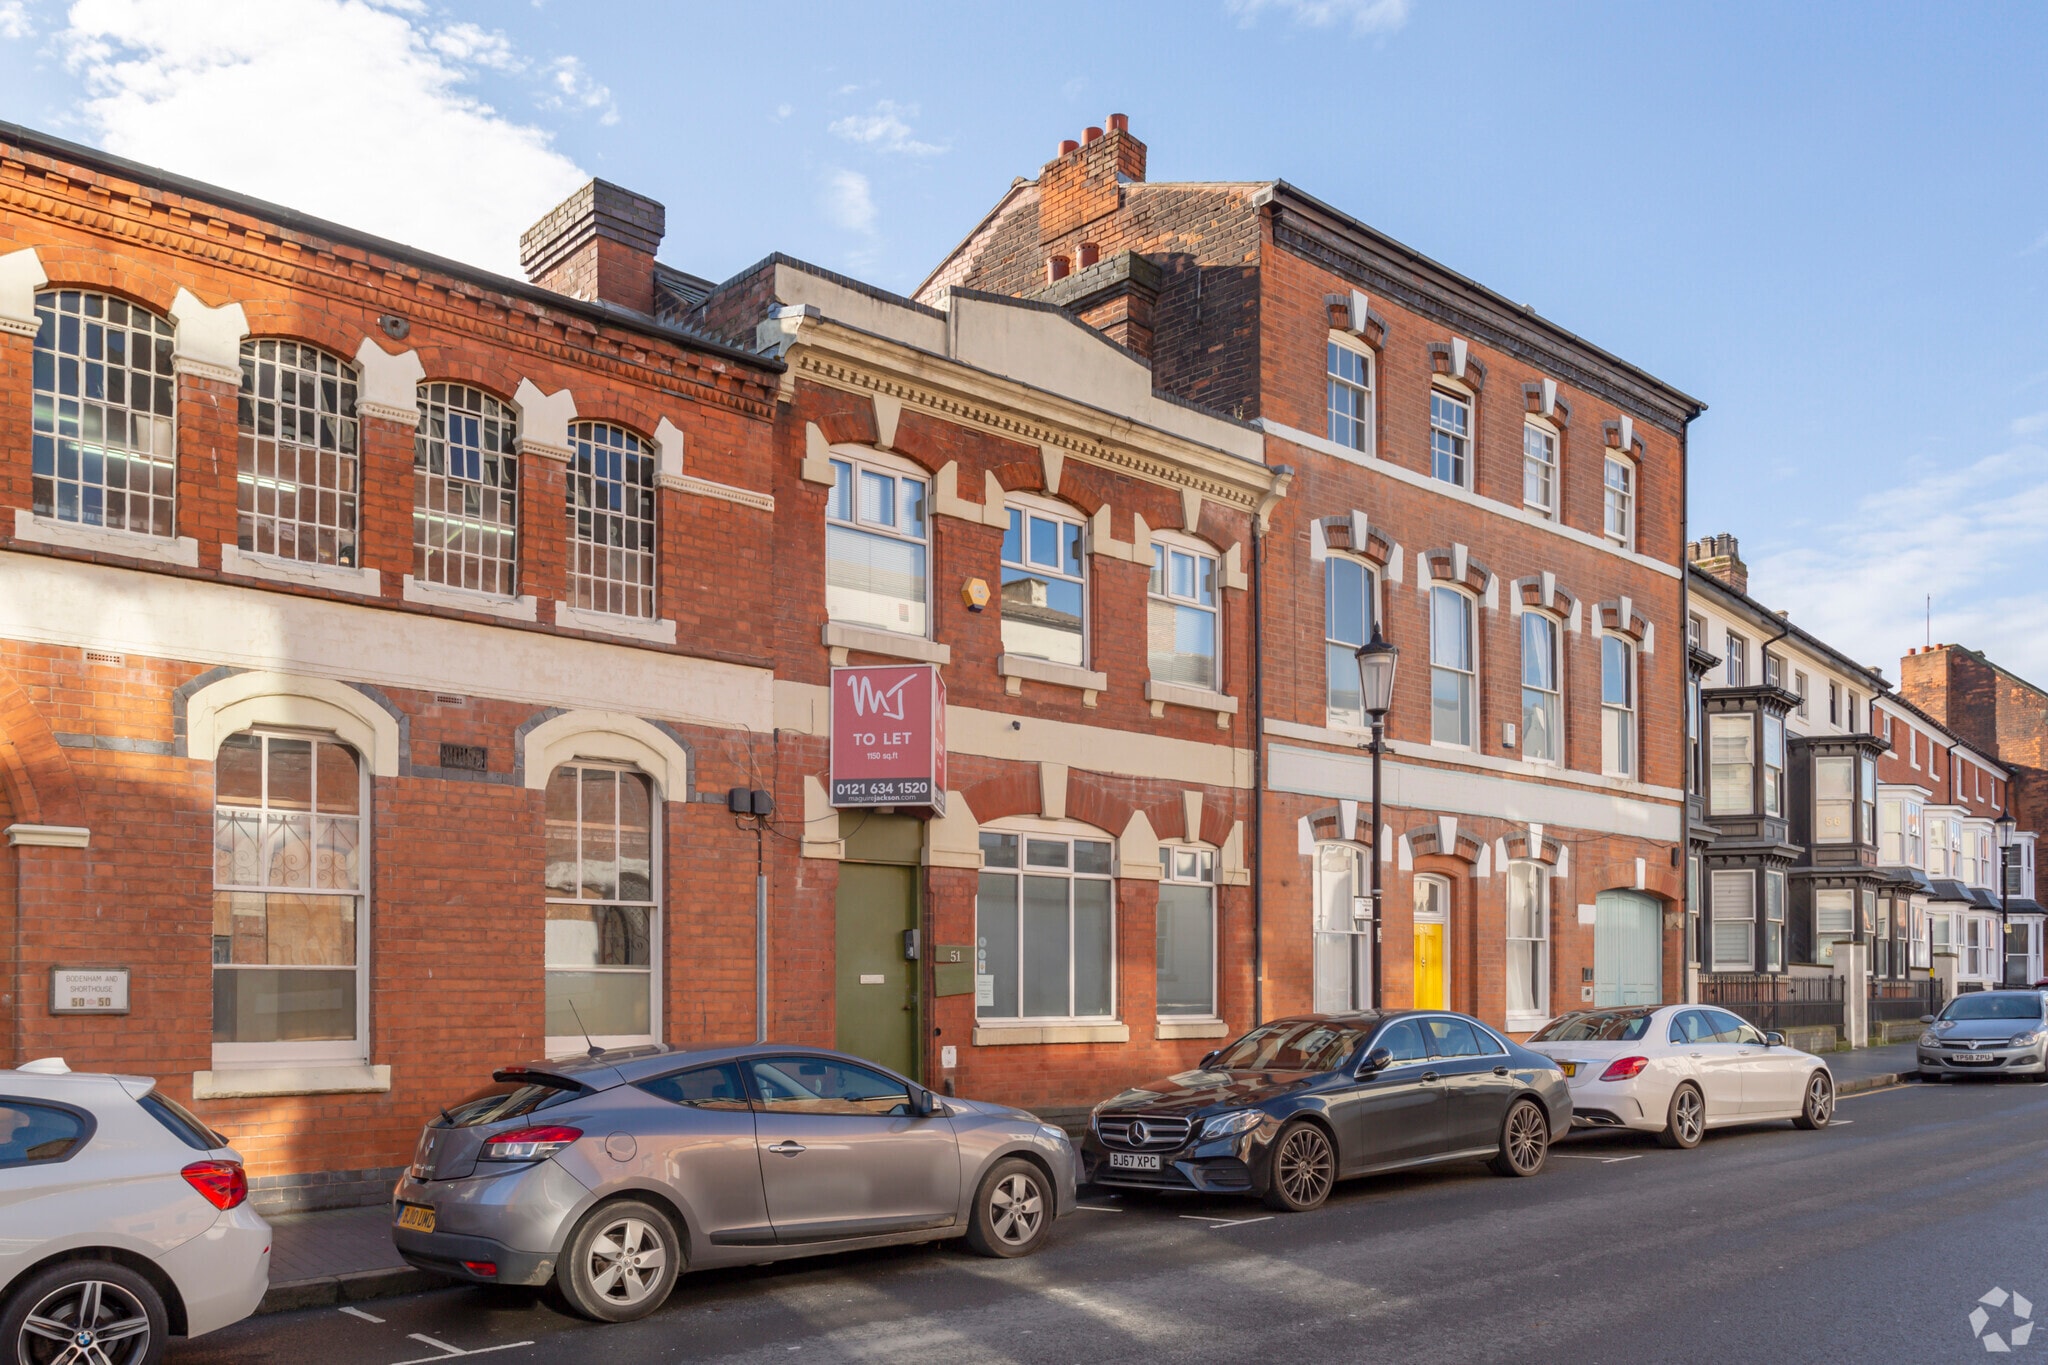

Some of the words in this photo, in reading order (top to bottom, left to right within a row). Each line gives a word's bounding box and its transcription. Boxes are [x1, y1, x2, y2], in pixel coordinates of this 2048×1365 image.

[853, 733, 876, 746] TO
[883, 732, 912, 745] LET
[867, 752, 881, 760] 1150
[836, 783, 866, 795] 0121
[870, 783, 894, 794] 634
[898, 782, 928, 794] 1520
[950, 951, 961, 962] 51
[98, 997, 111, 1006] 50
[1113, 1154, 1135, 1167] BJ67
[1137, 1156, 1157, 1168] XPC
